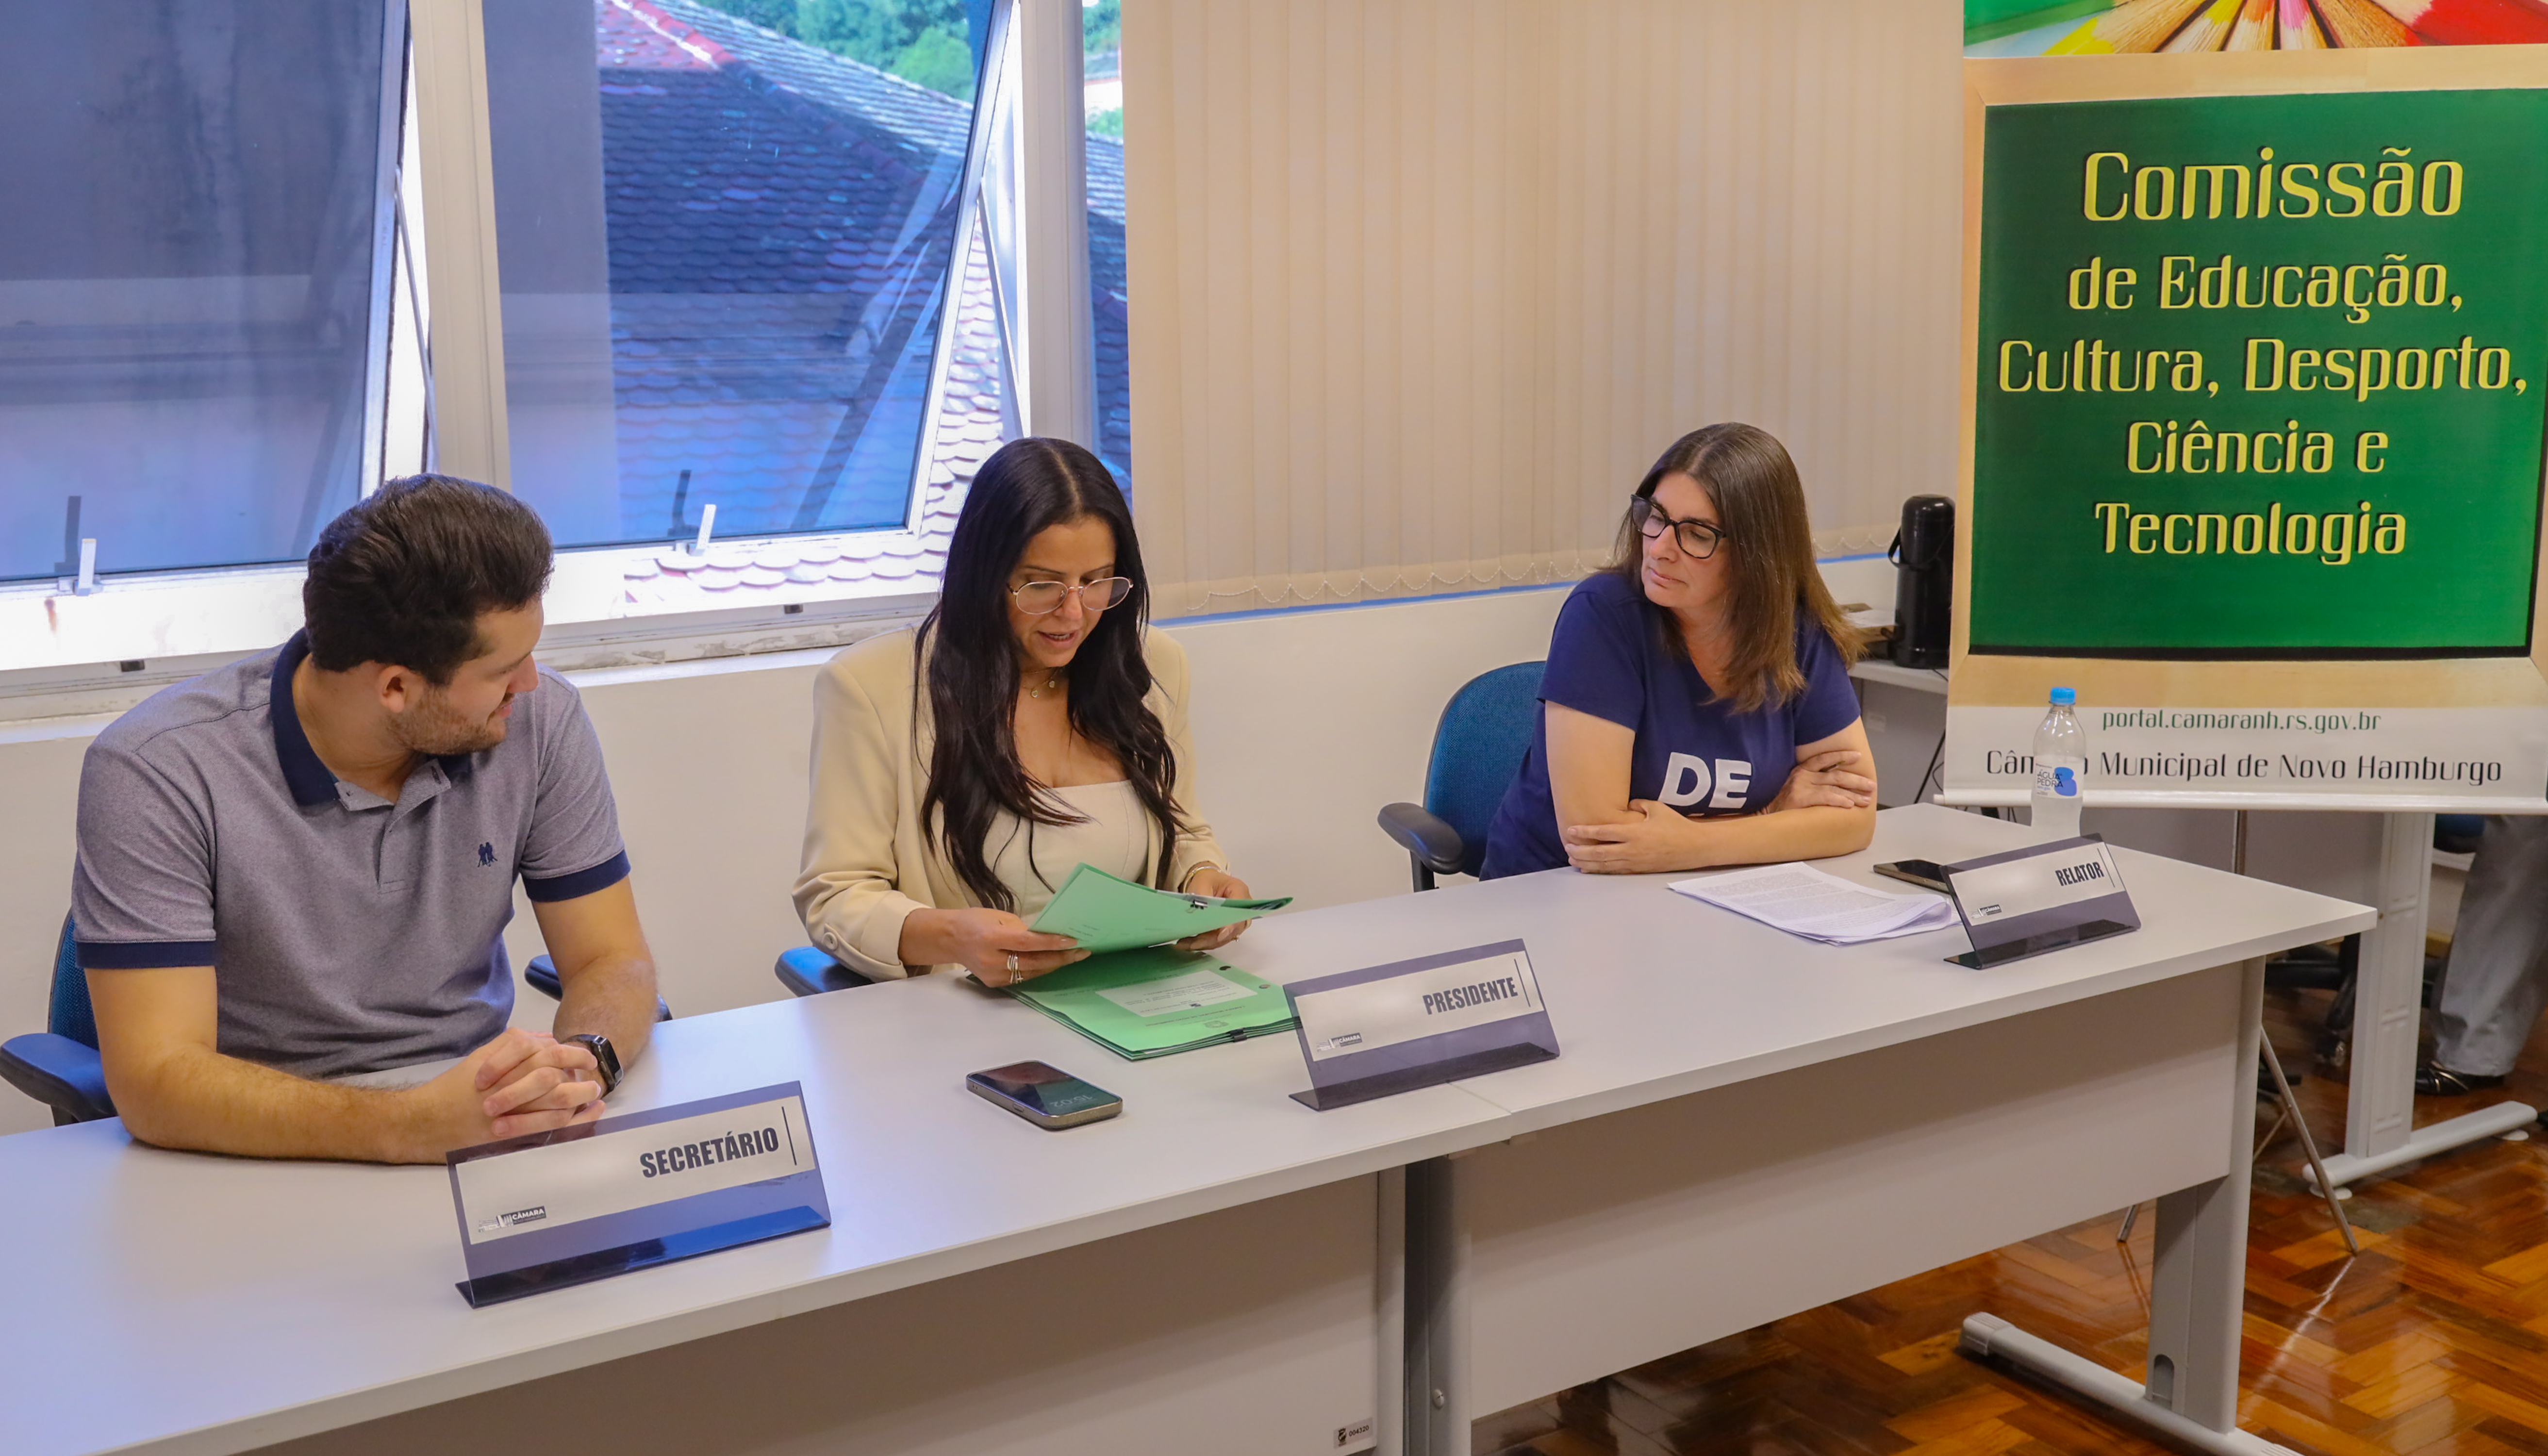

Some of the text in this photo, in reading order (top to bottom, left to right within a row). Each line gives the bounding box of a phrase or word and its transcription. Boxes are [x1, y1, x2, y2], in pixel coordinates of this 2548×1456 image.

[2084, 147, 2464, 221] Comissão
[2068, 254, 2463, 324] de Educação,
[1999, 336, 2527, 402] Cultura, Desporto,
[2127, 420, 2388, 474] Ciência e
[2095, 501, 2406, 565] Tecnologia
[2103, 710, 2381, 733] portal.camaranh.rs.gov.br
[1658, 752, 1752, 809] DE
[1987, 750, 2501, 786] Câm Municipal de Novo Hamburgo
[2037, 769, 2061, 780] ÁGUA
[2037, 778, 2064, 788] PEDRA
[2055, 861, 2104, 886] RELATOR
[1423, 977, 1518, 1015] PRESIDENTE
[640, 1127, 779, 1178] SECRETÁRIO
[512, 1208, 545, 1220] CÂMARA
[1349, 1425, 1369, 1437] 004320
